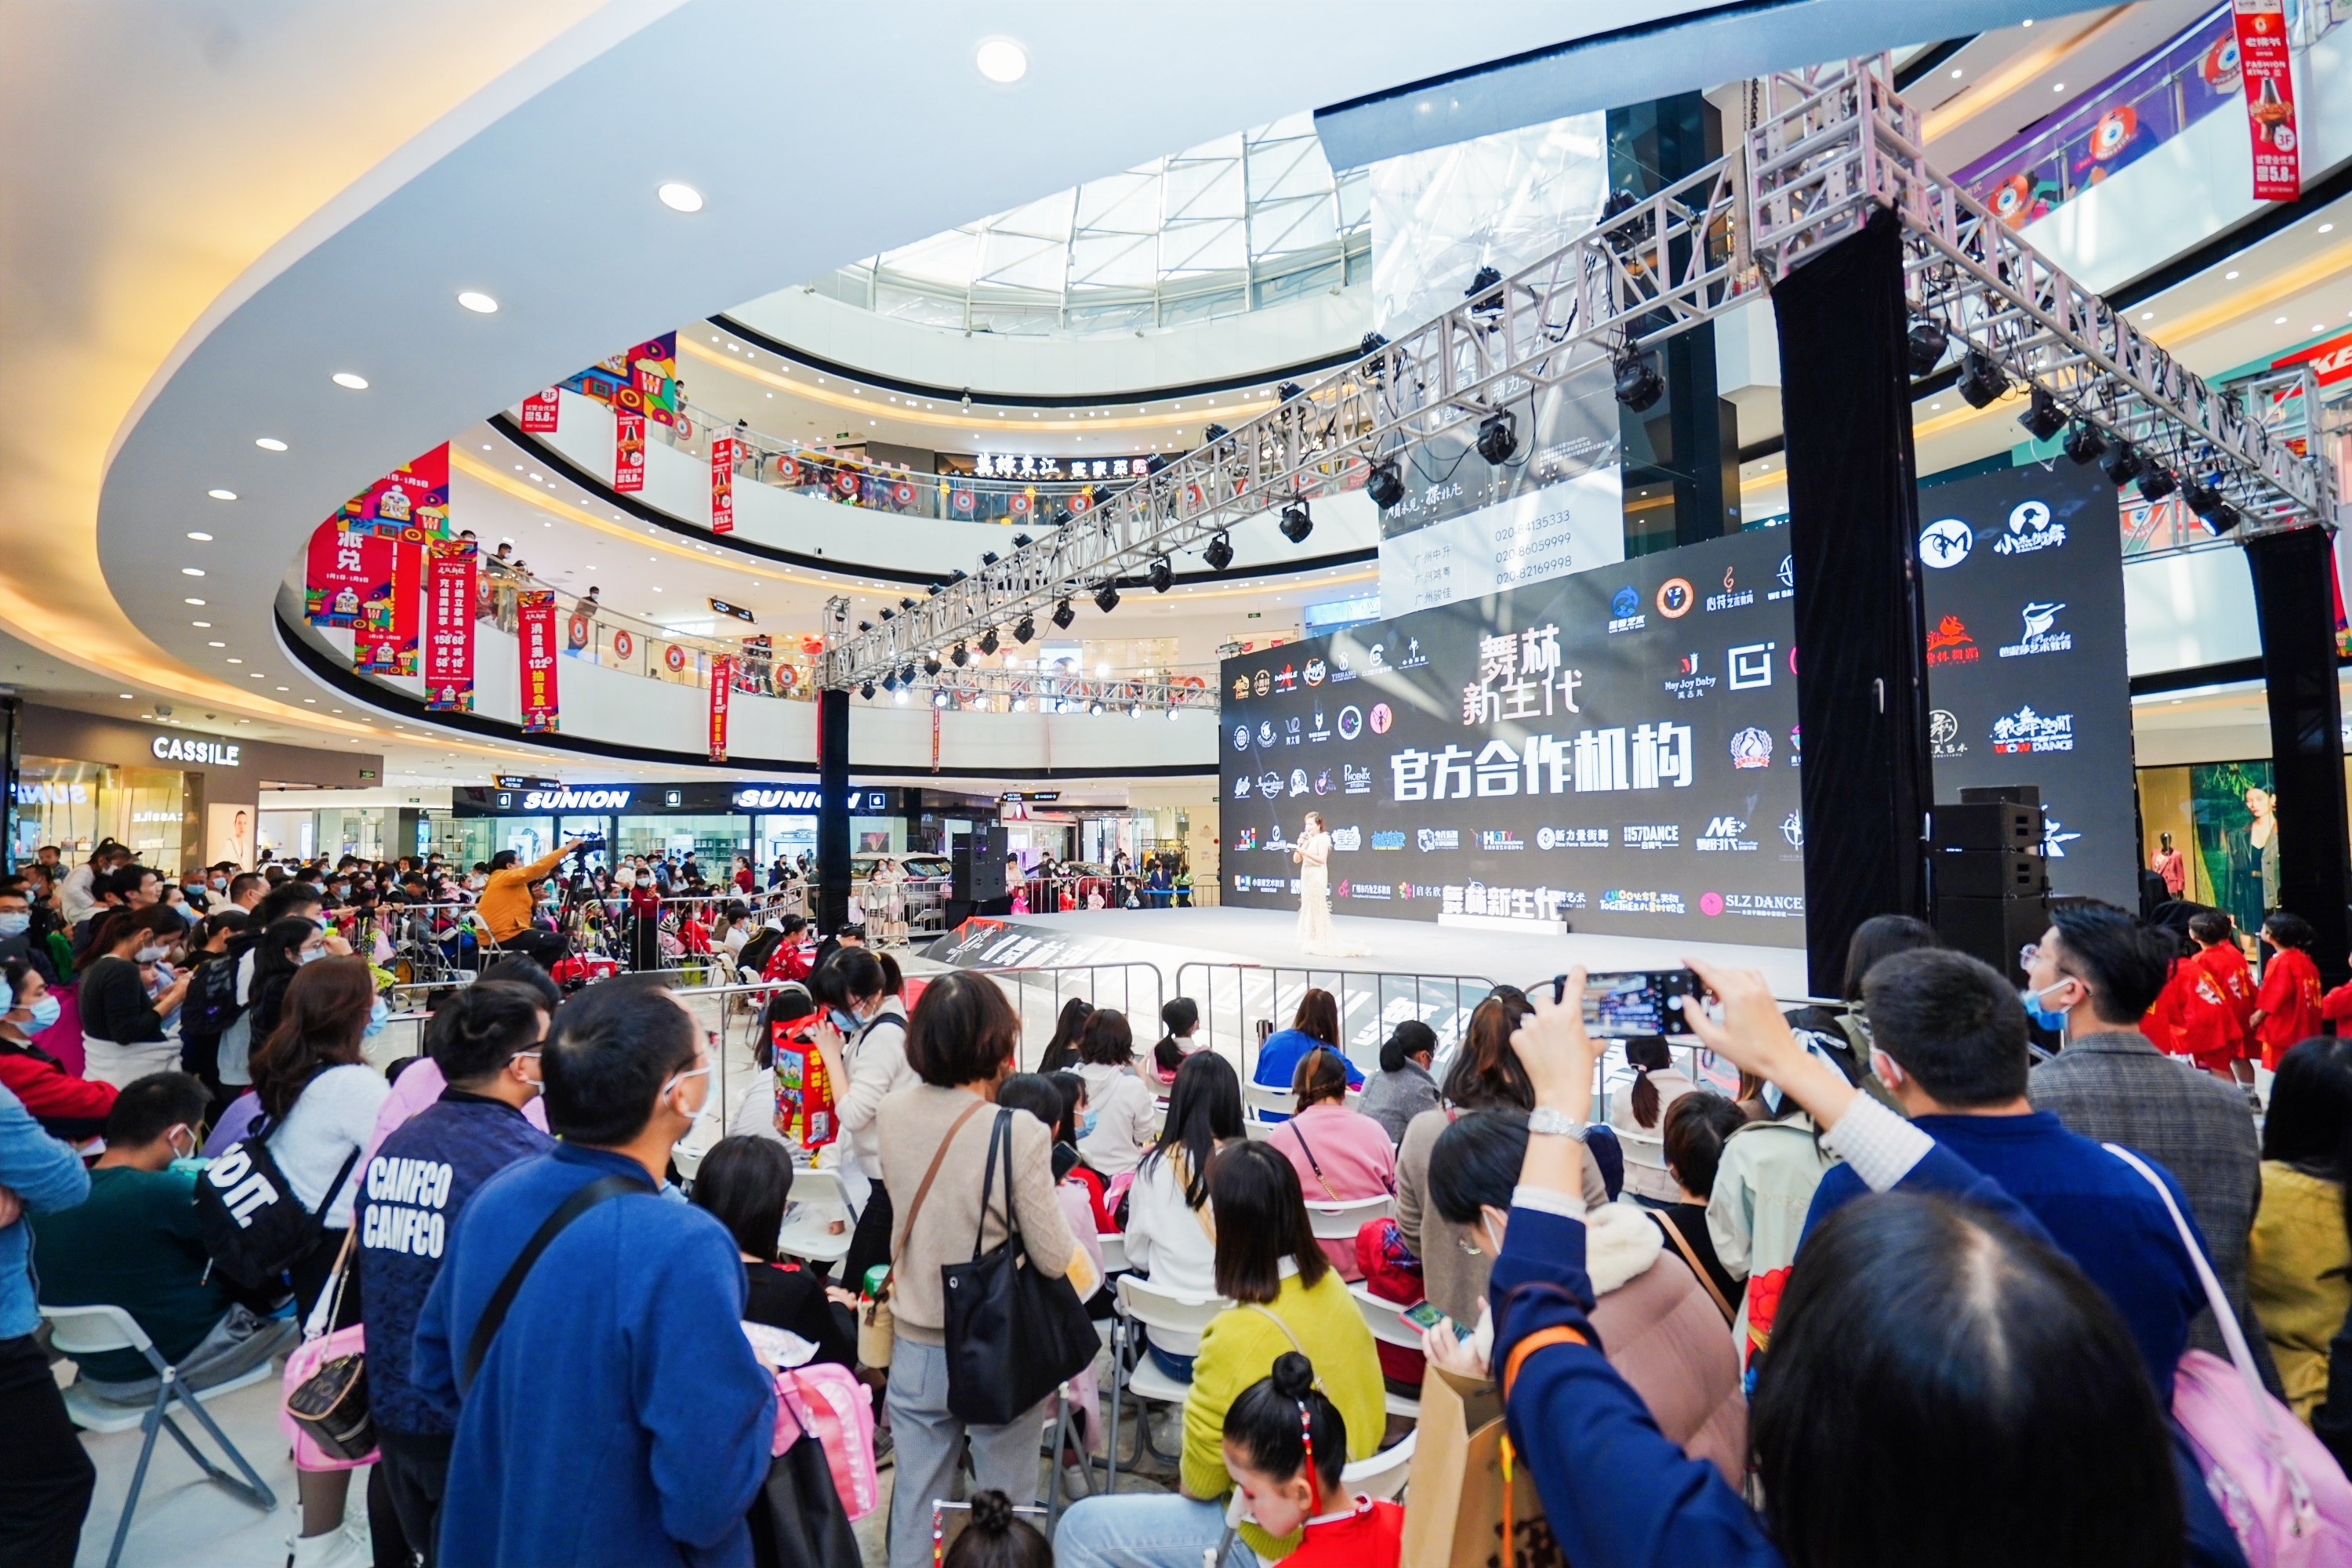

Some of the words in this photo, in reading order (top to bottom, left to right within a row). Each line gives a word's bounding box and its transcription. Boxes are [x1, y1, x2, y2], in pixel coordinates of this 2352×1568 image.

[2245, 60, 2287, 69] FASHION
[2278, 134, 2292, 147] 3F
[543, 391, 555, 400] 3F
[1495, 510, 1570, 543] 020-84135333
[1414, 546, 1451, 567] 广州中升
[1495, 532, 1571, 564] 020-86059999
[1496, 555, 1572, 586] 020-82169998
[1480, 623, 1562, 686] 舞林
[1664, 681, 1680, 692] May
[1679, 679, 1694, 690] Joy
[1695, 676, 1716, 688] Baby
[1462, 670, 1582, 727] 新生代
[152, 735, 240, 768] CASSILE
[1994, 742, 2031, 754] WOW
[2032, 739, 2074, 753] DANCE
[1344, 764, 1371, 782] PHOENIX
[1390, 721, 1693, 801] 官方合作机构
[522, 790, 632, 809] SUNION
[1555, 828, 1609, 842] 新力量街舞
[1442, 884, 1563, 921] 舞林新生代
[1725, 894, 1752, 908] SLZ
[1754, 895, 1804, 910] DANCE
[367, 1156, 454, 1210] CANFCO
[362, 1203, 445, 1259] CANFCO
